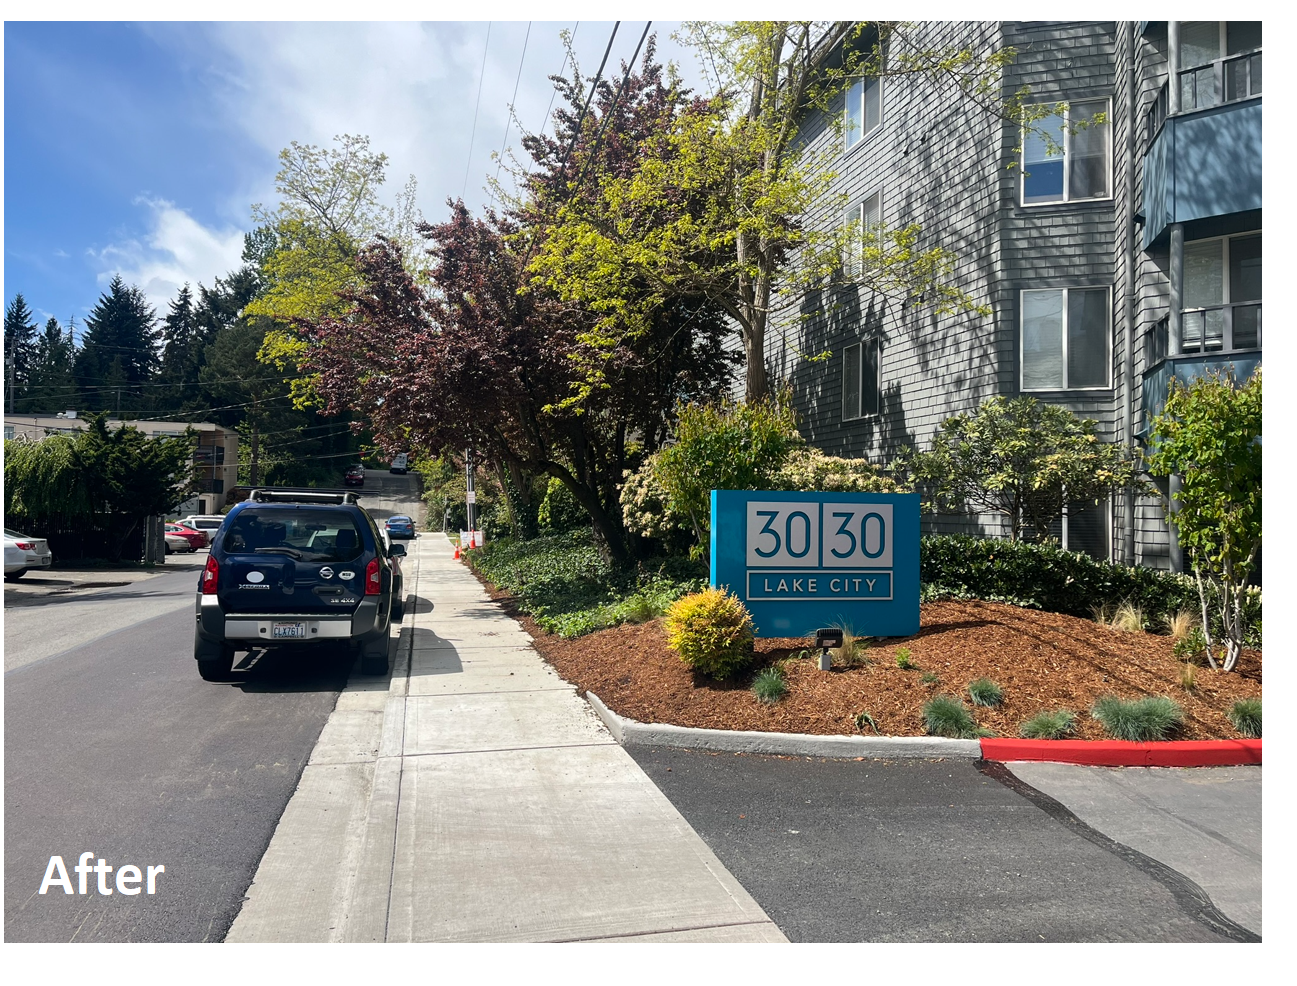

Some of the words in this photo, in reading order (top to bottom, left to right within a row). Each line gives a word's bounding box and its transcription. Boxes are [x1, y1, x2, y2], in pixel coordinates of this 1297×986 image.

[764, 578, 818, 592] LAKE
[829, 578, 877, 592] CITY
[273, 627, 304, 636] CLX7611
